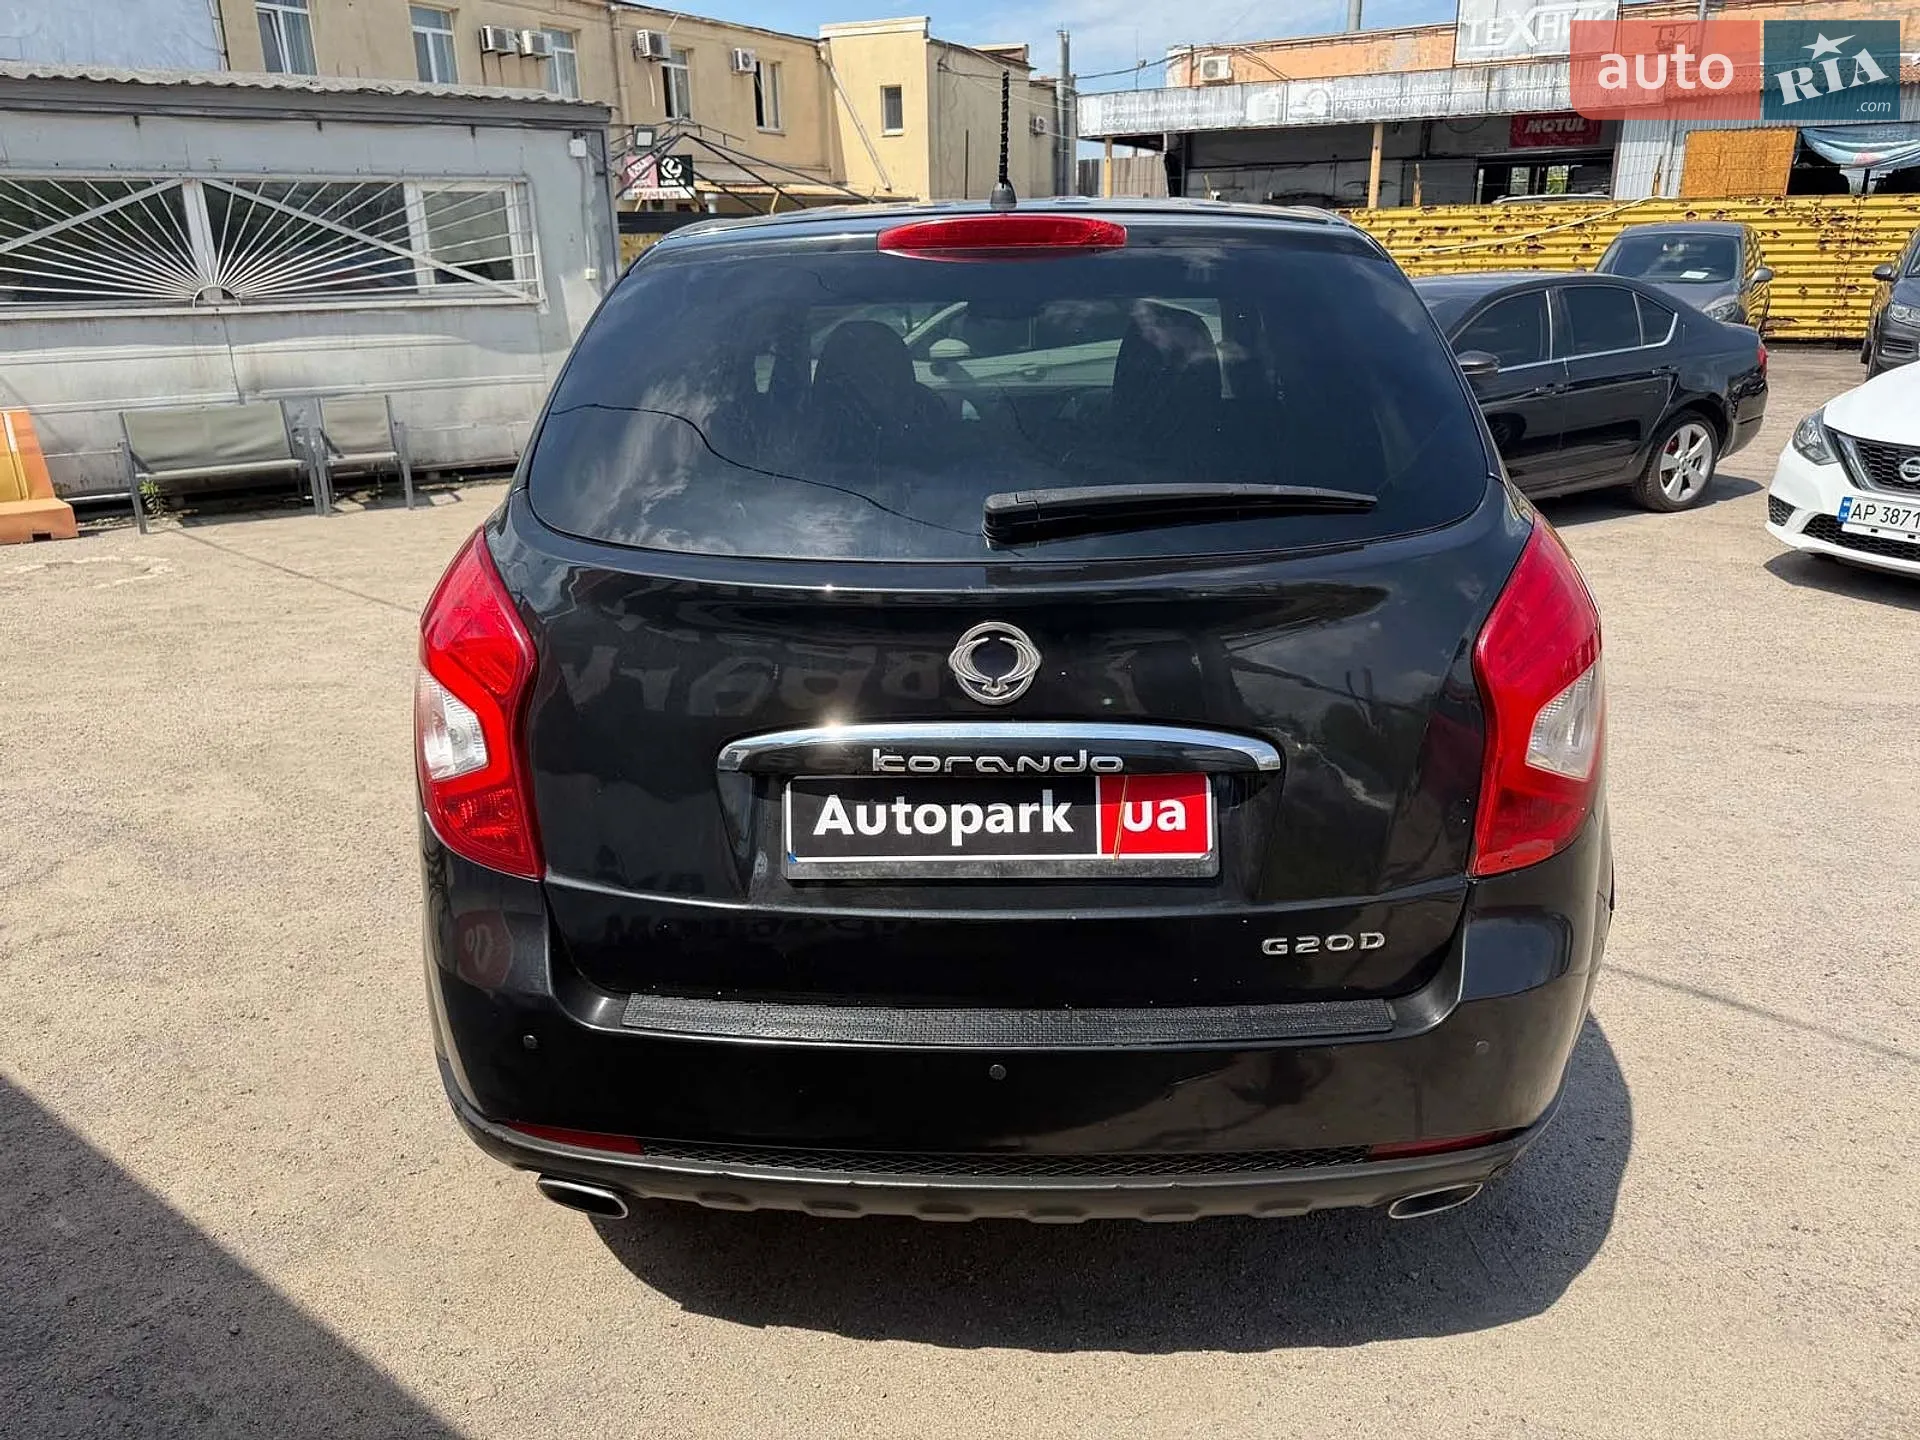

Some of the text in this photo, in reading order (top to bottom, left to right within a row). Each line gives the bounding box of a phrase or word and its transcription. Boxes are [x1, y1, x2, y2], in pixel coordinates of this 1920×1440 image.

[1525, 117, 1585, 134] MOTUL
[872, 748, 1124, 773] korando
[812, 789, 1186, 846] Autopark ua
[1261, 932, 1385, 956] G20D
